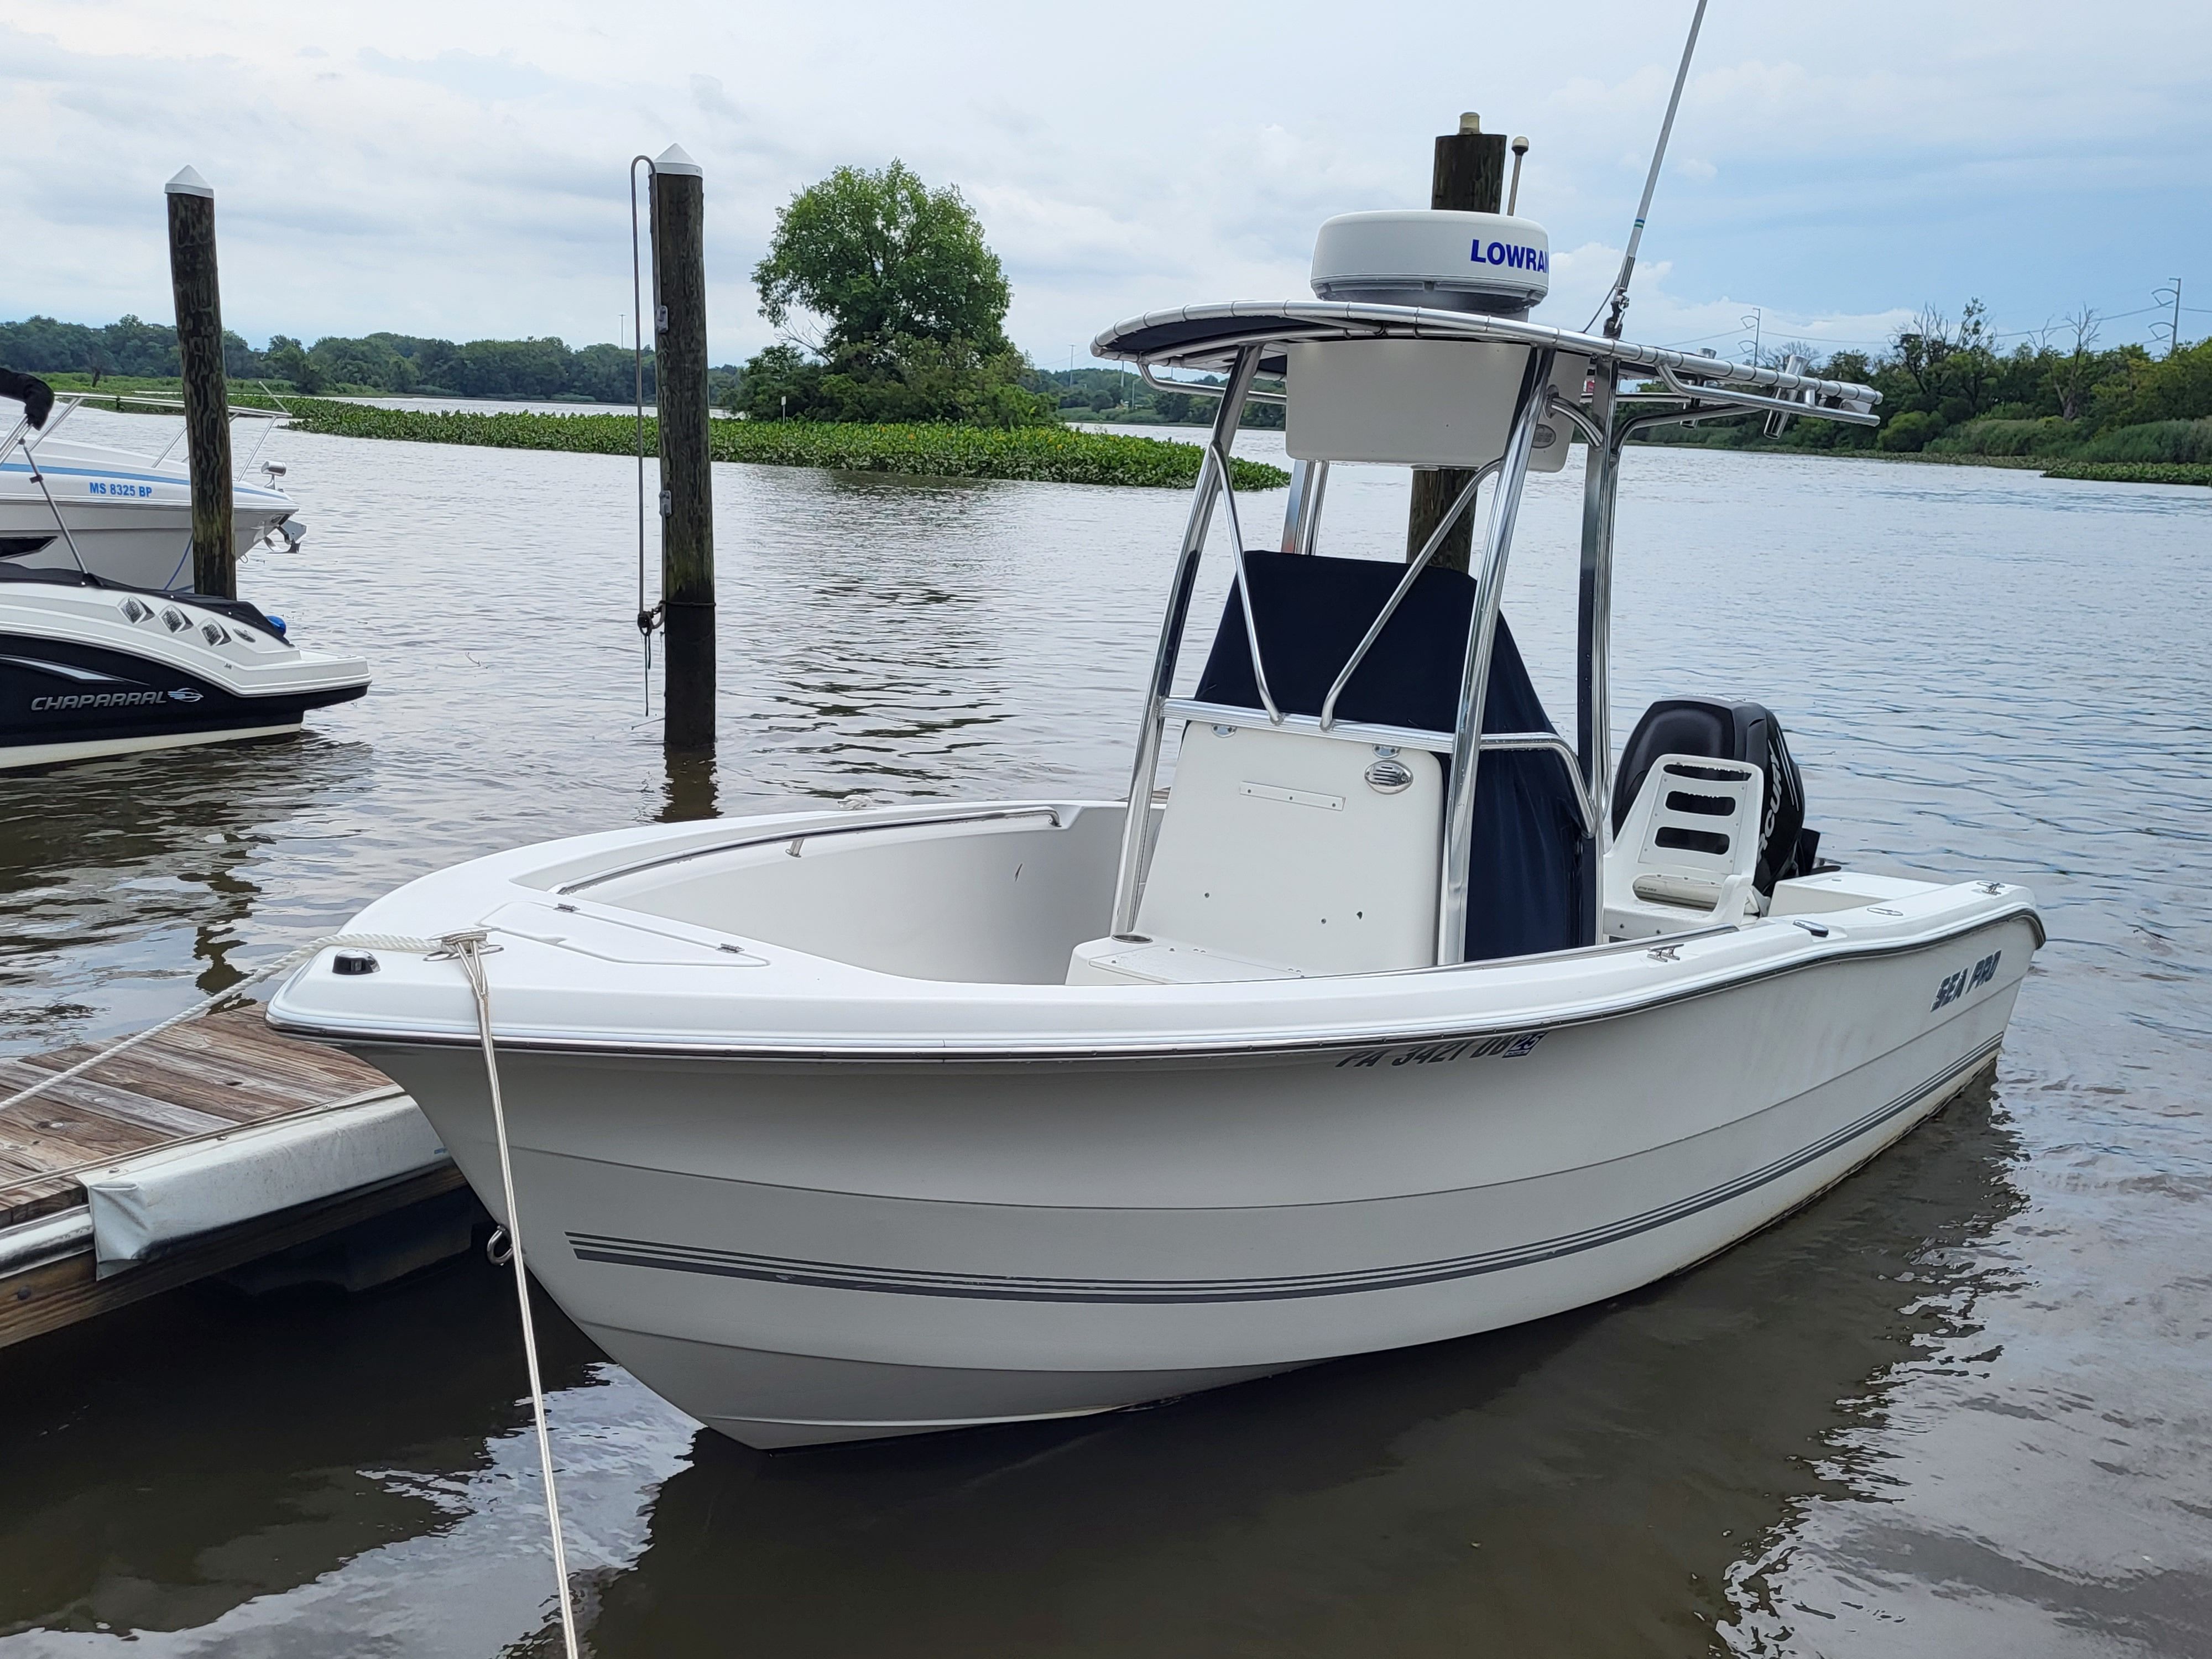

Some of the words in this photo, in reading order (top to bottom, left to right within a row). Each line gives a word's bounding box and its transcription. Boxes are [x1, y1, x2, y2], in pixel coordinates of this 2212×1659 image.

[89, 482, 106, 494] MS
[110, 483, 135, 496] 8325
[139, 486, 152, 497] BP
[31, 691, 166, 711] CHAPARRAL
[1929, 967, 1969, 1013] SEA
[1965, 950, 2002, 994] PRO
[1509, 1032, 1546, 1050] 25
[1335, 1050, 1391, 1067] PA
